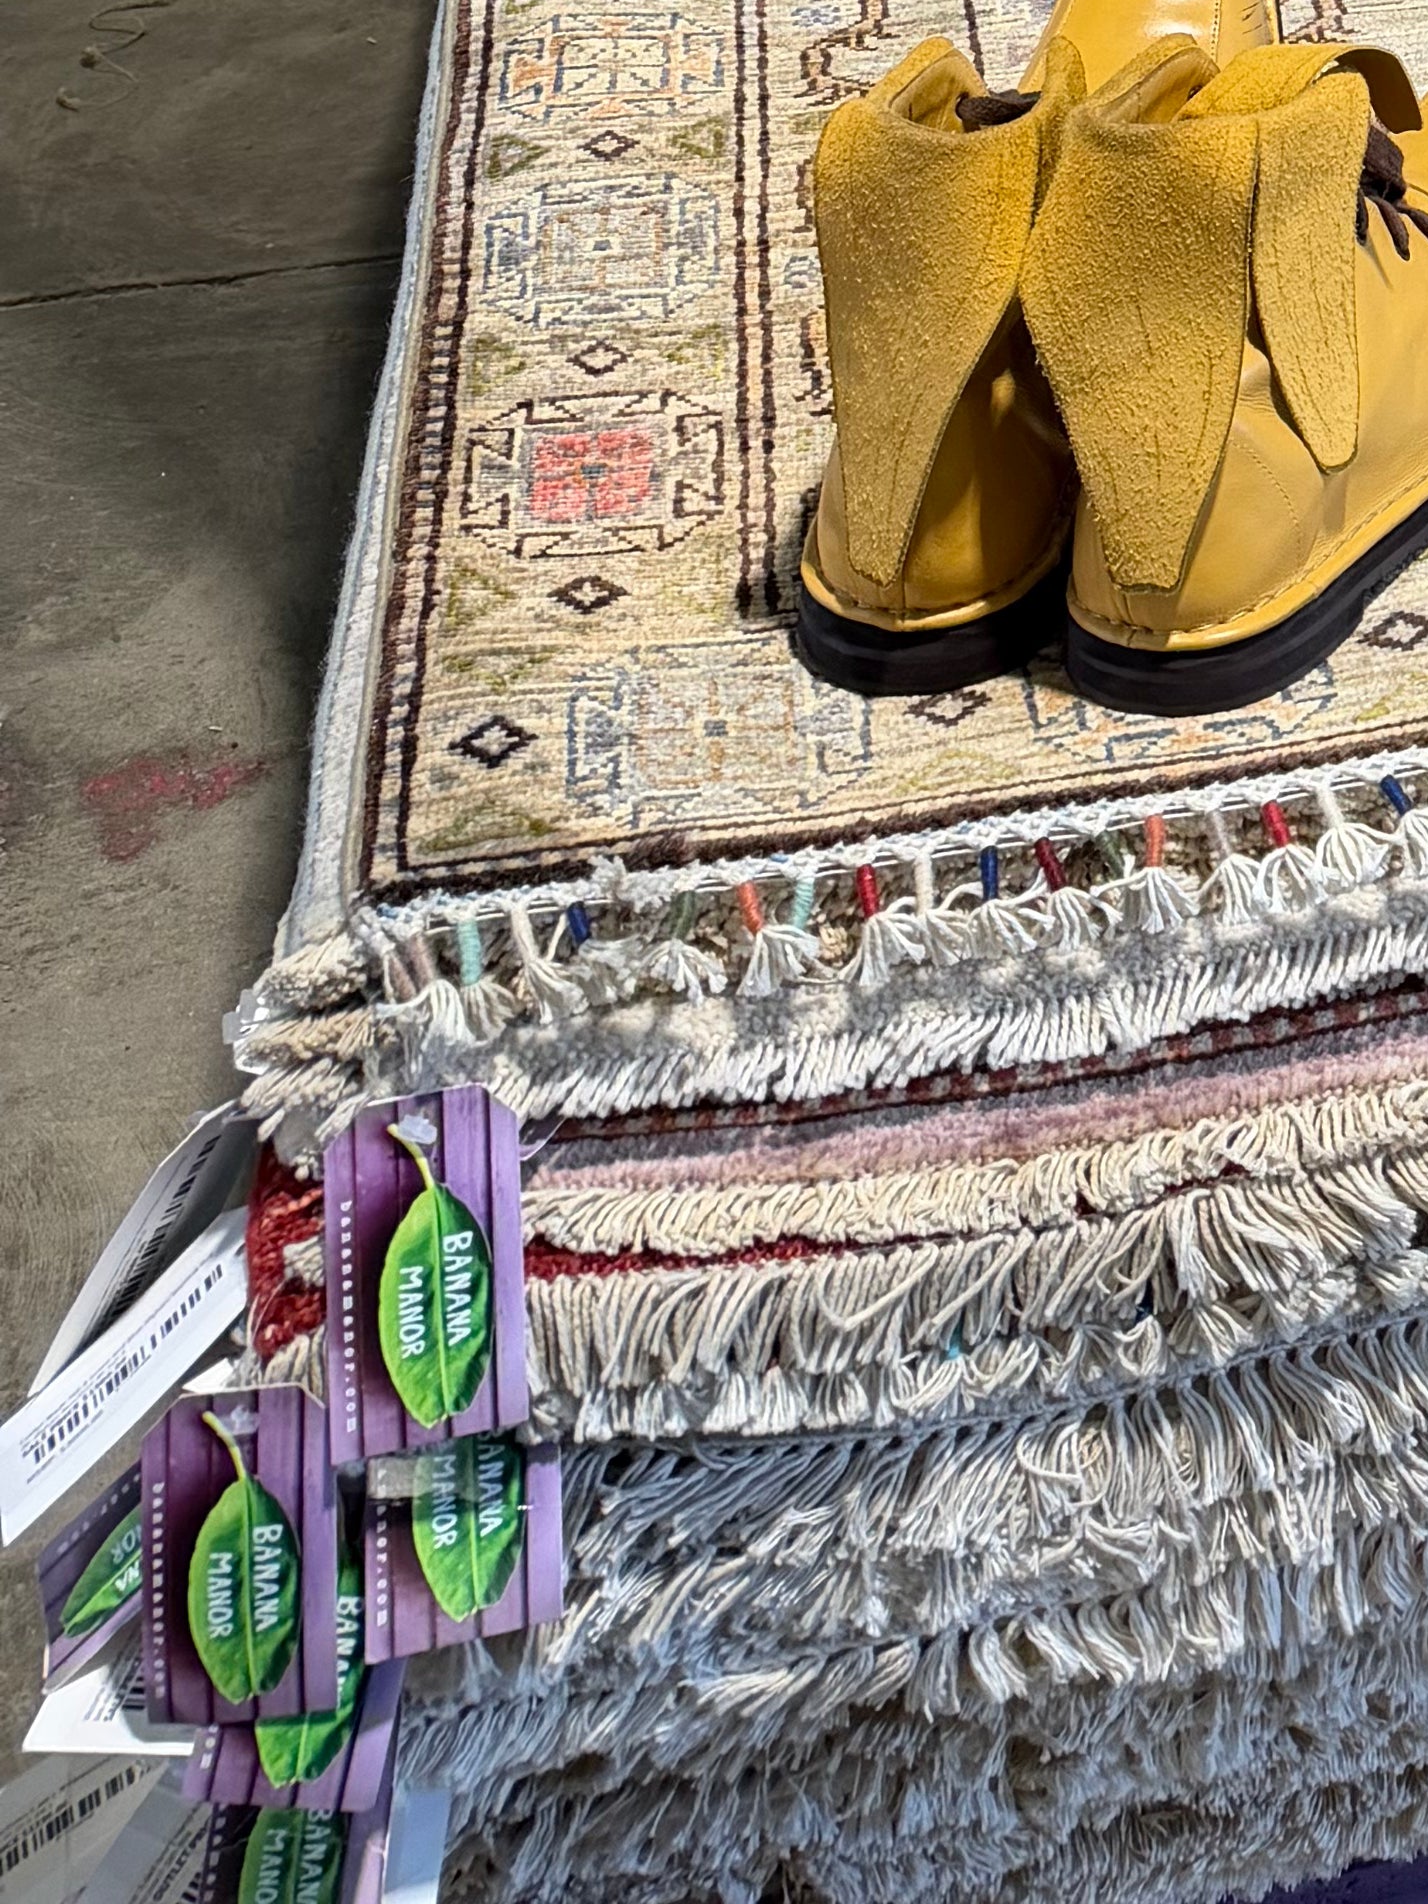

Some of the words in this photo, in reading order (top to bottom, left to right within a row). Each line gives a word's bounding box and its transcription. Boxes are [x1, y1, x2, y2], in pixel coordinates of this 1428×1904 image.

[397, 1265, 425, 1360] MANOR
[442, 1229, 474, 1347] BANANA
[431, 1454, 458, 1550] MANOR
[206, 1551, 235, 1639] MANOR
[252, 1523, 284, 1633] BANANA
[254, 1827, 288, 1904] MANO
